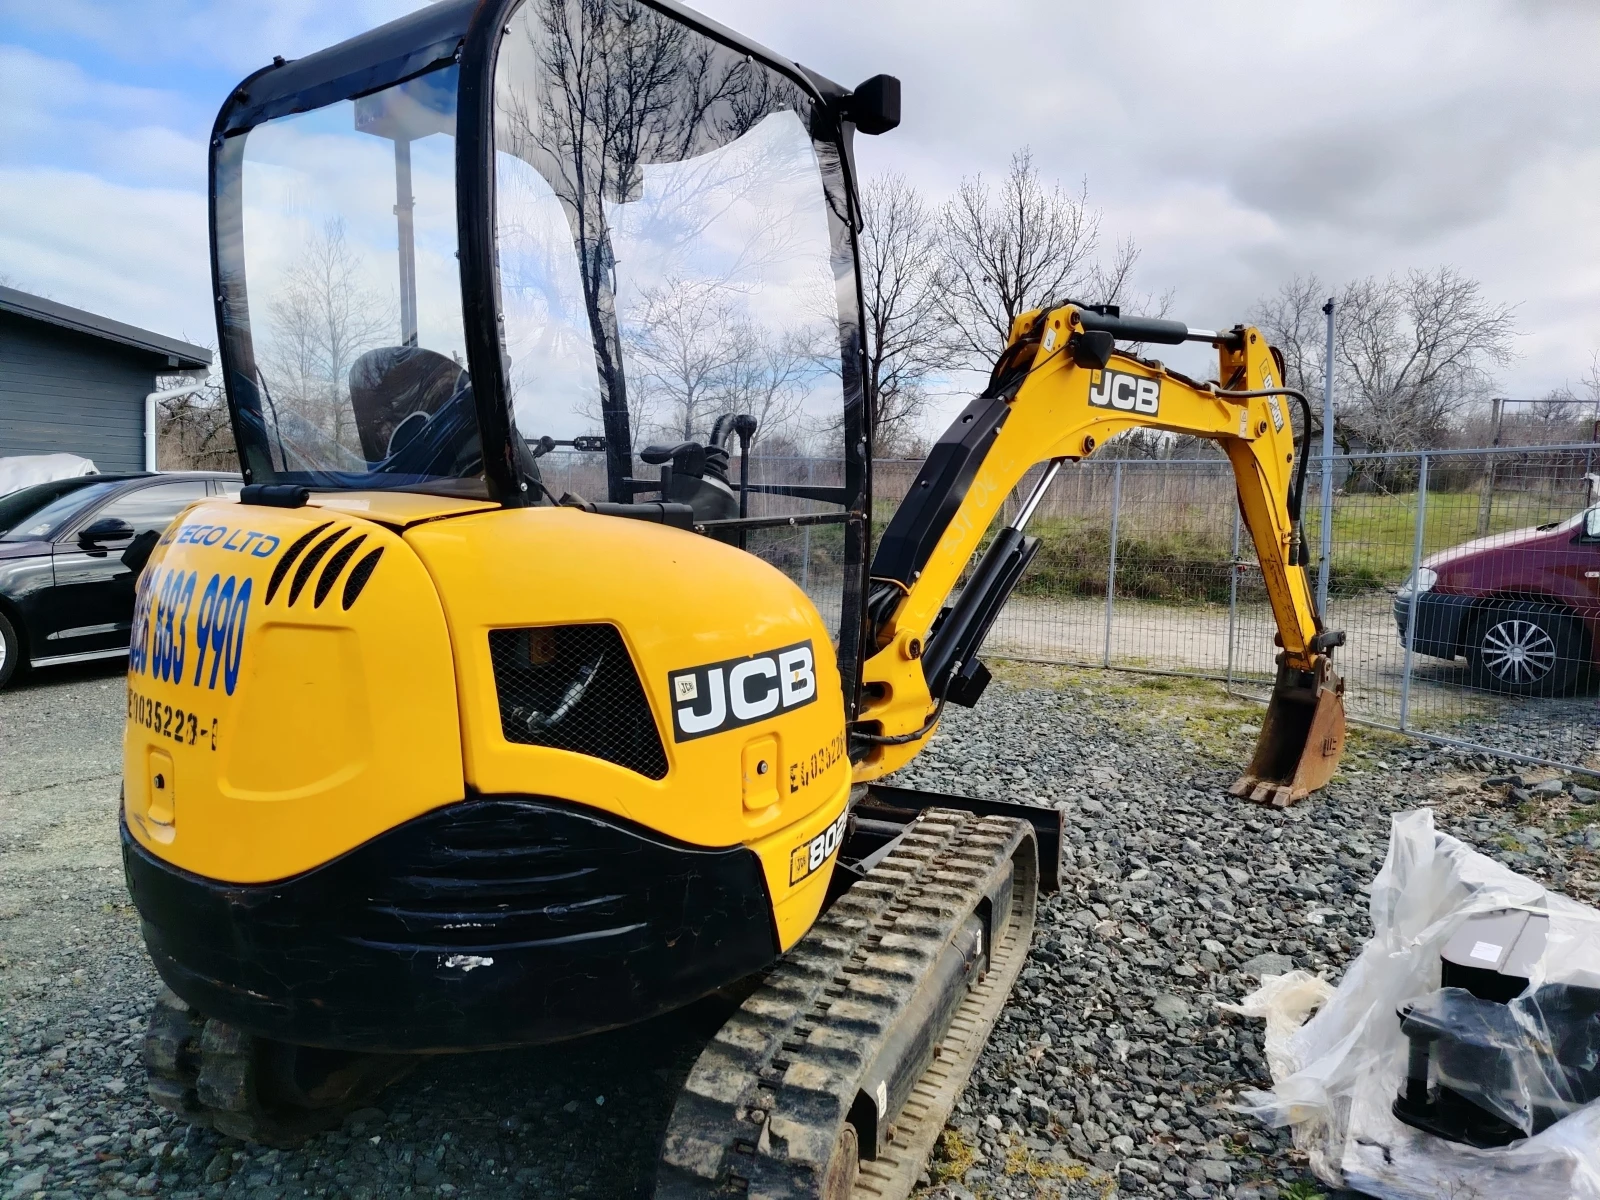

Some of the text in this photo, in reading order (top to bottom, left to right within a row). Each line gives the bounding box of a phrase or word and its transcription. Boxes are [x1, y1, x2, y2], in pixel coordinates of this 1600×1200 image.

[1091, 371, 1159, 414] JCB
[222, 529, 281, 558] LTD
[194, 573, 253, 696] 990
[677, 646, 815, 734] JCB
